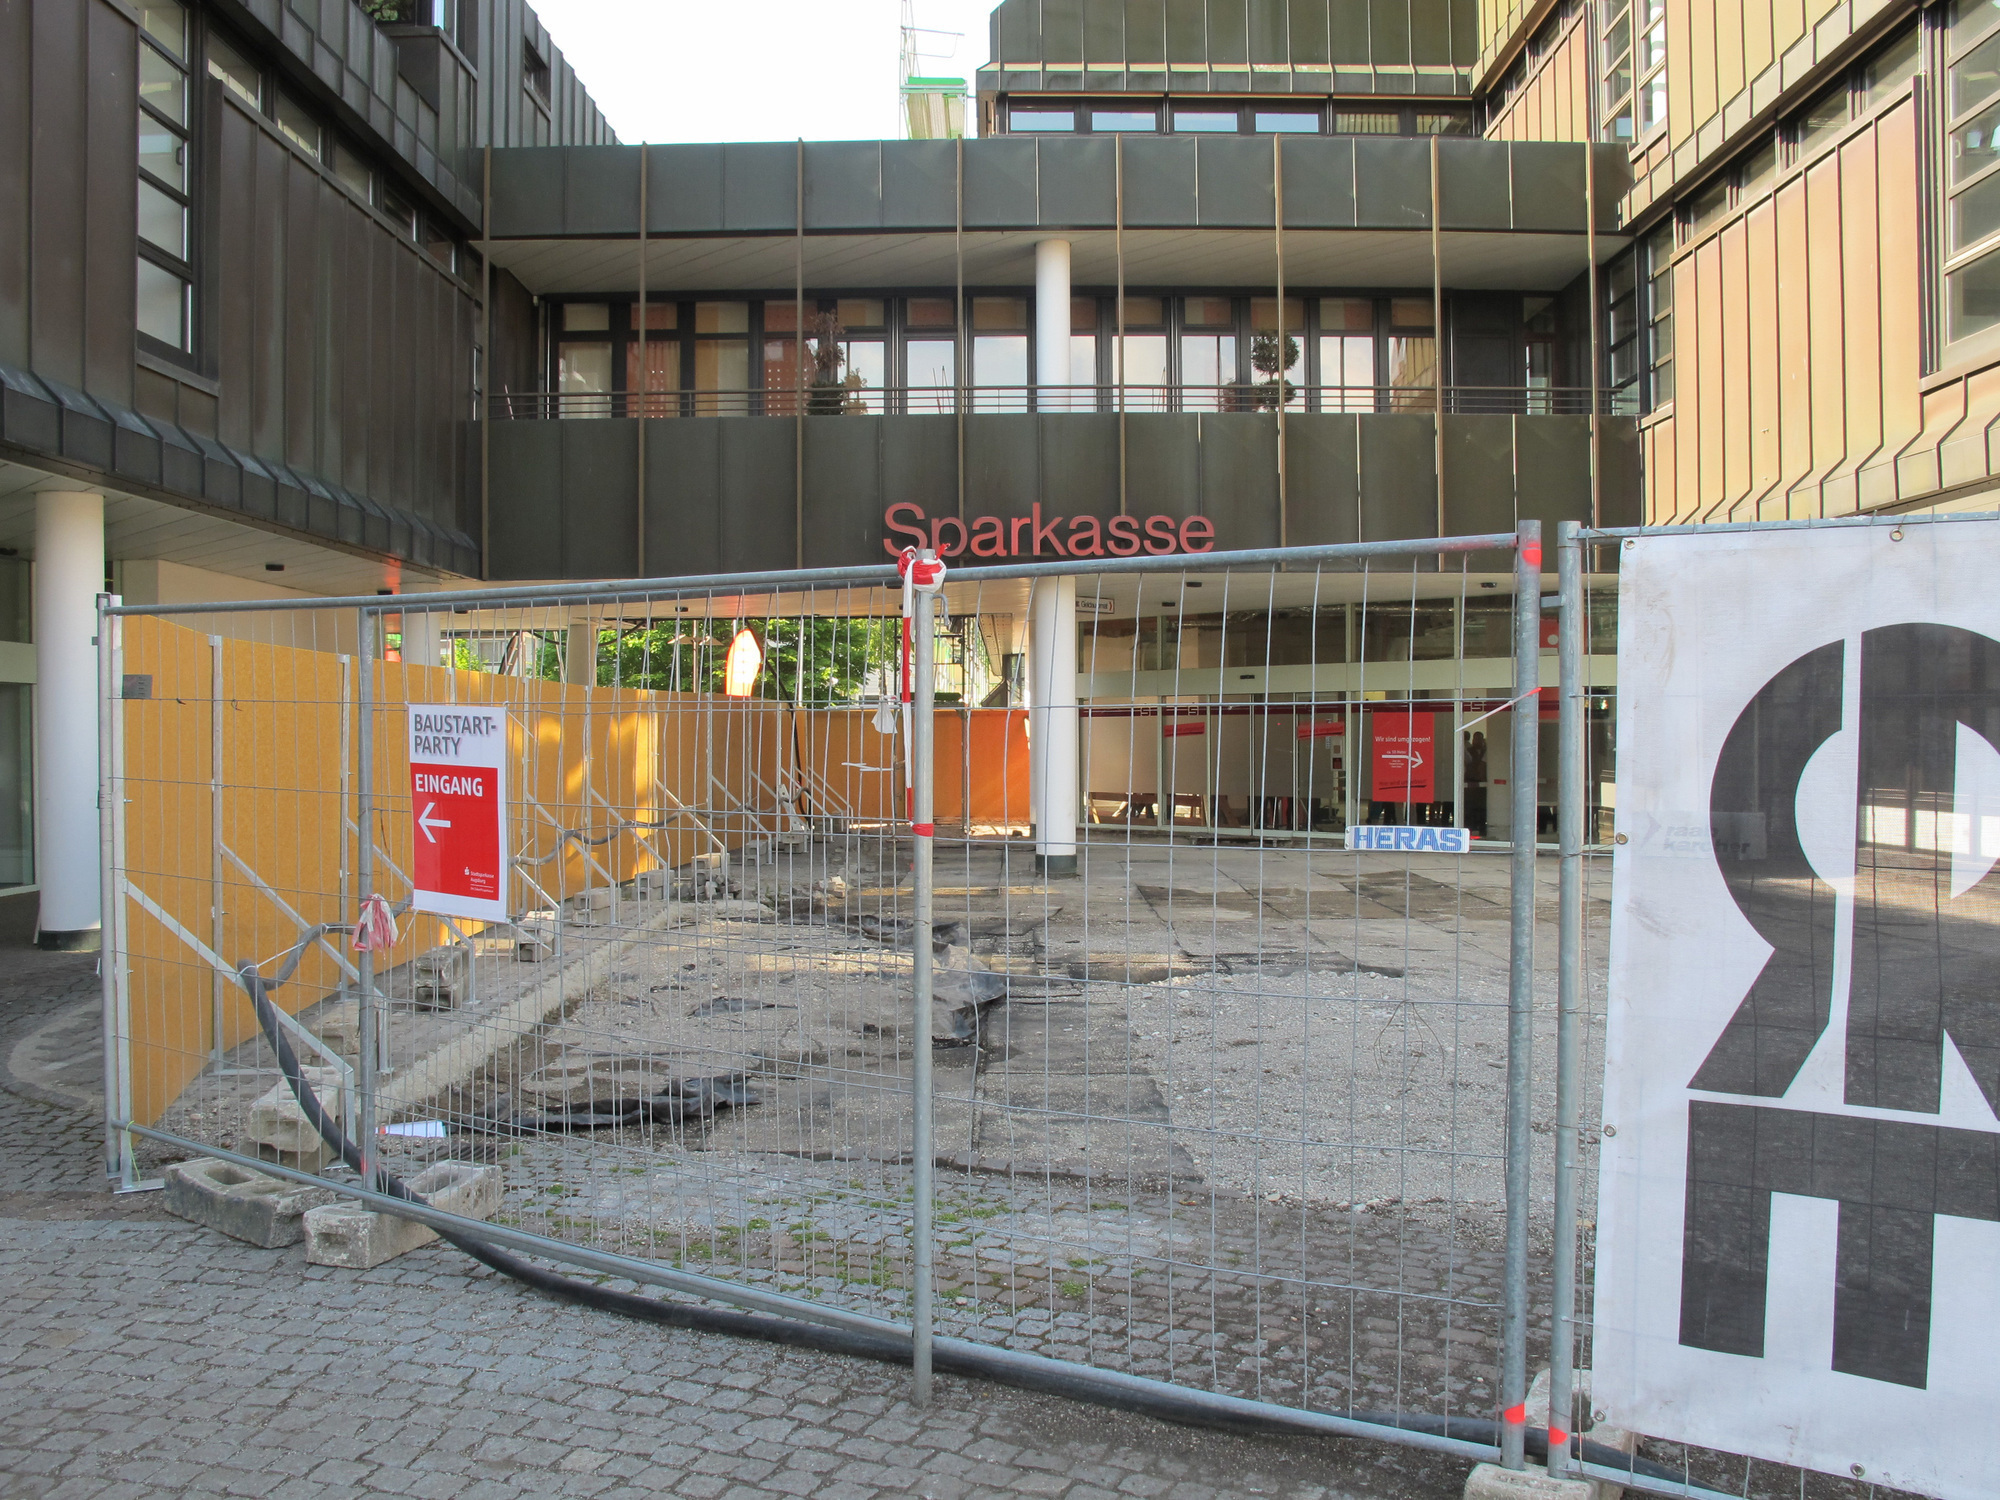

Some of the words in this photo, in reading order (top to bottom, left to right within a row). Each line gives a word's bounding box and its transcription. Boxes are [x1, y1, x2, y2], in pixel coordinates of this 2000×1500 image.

[883, 502, 1215, 557] Sparkasse
[414, 713, 497, 736] BAUSTART-
[414, 735, 461, 755] PARTY
[415, 773, 483, 797] EINGANG
[1353, 827, 1462, 851] HERAS
